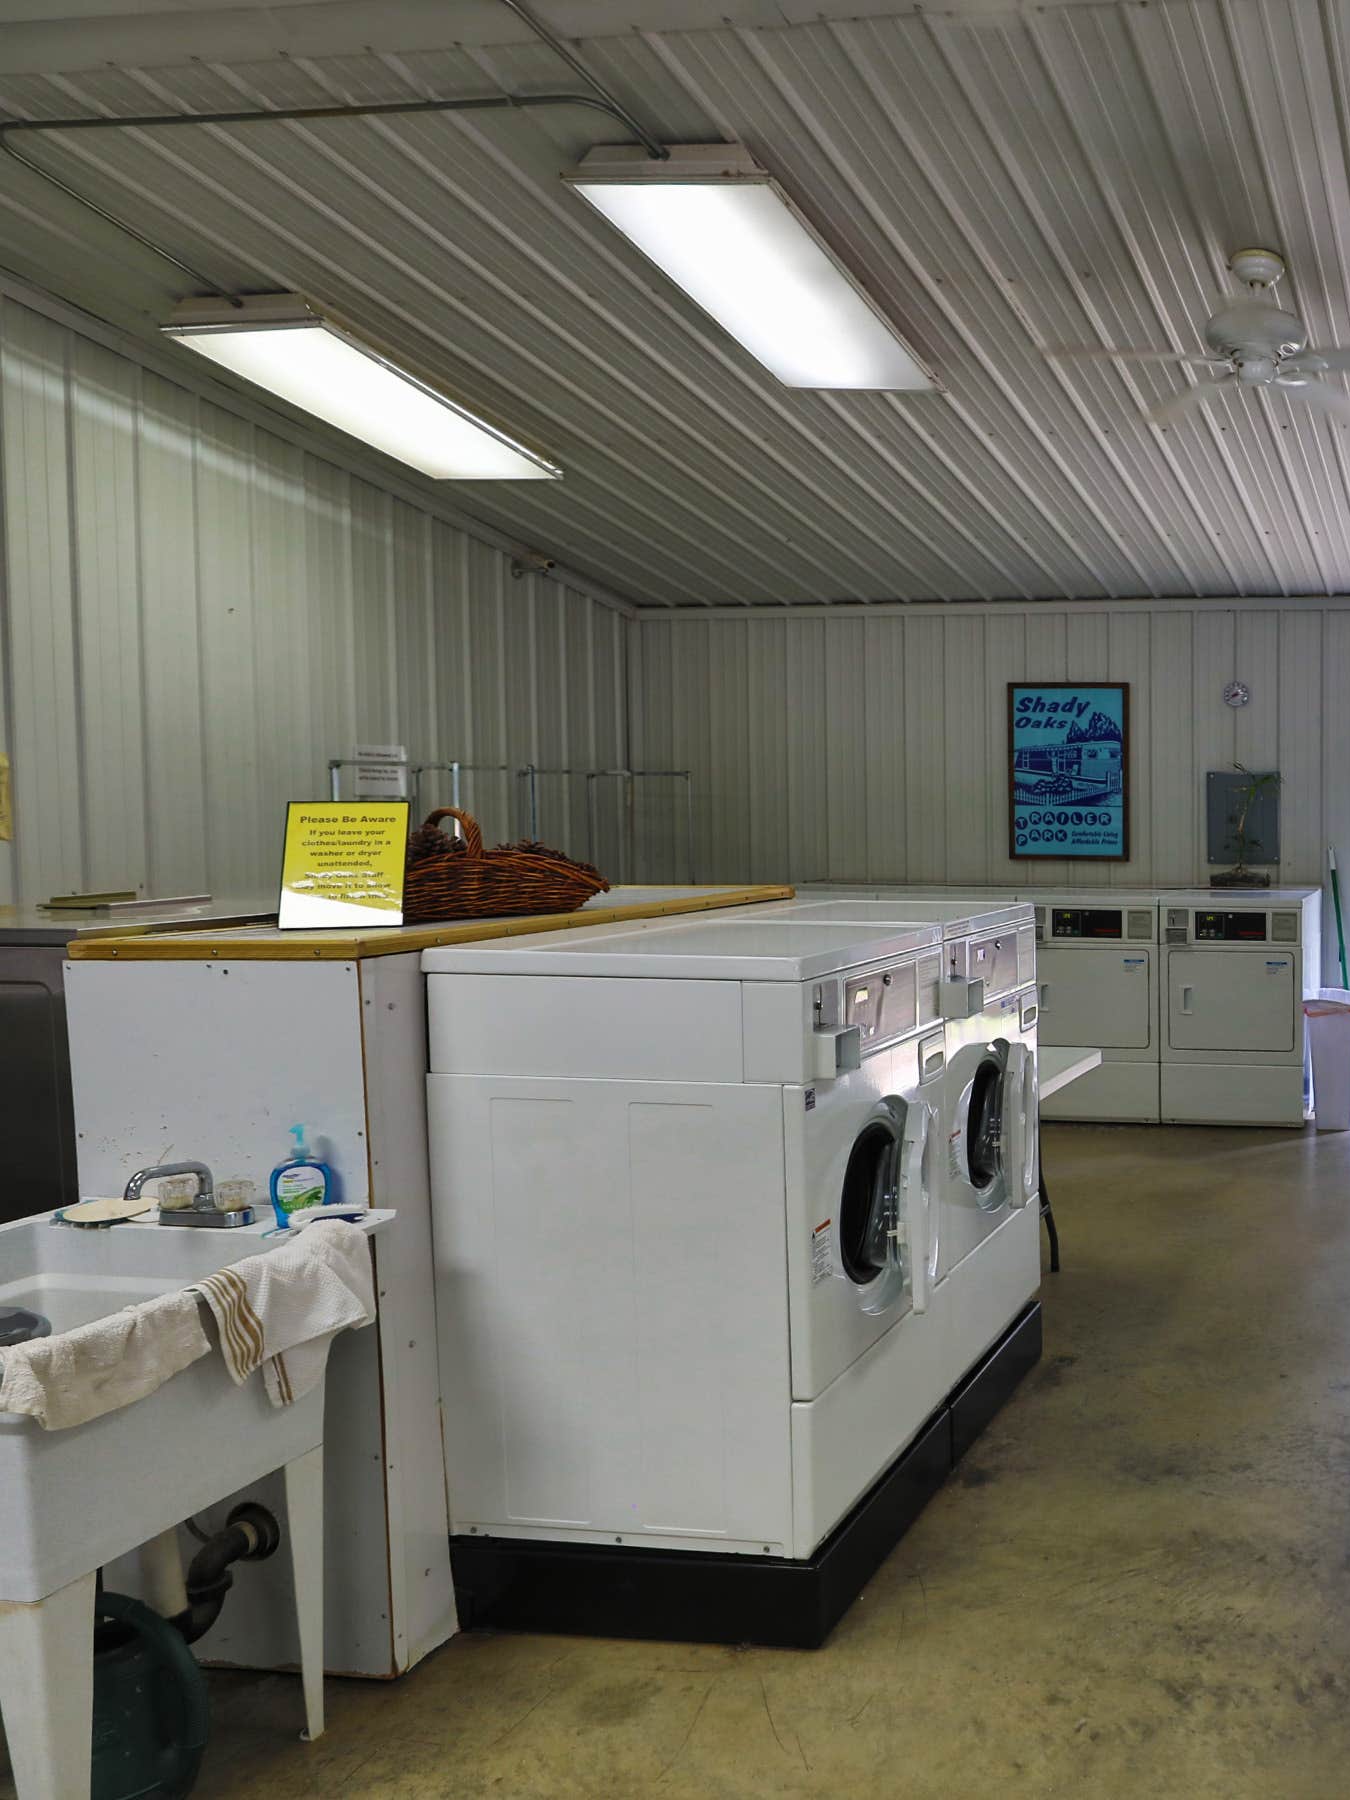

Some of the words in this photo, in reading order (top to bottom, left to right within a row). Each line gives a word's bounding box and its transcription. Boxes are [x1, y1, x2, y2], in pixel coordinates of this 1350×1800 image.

[1015, 696, 1091, 718] Shady
[1014, 716, 1069, 729] Oaks
[1016, 811, 1112, 830] TRAILER
[1016, 829, 1068, 847] PARK
[358, 849, 382, 857] dryer
